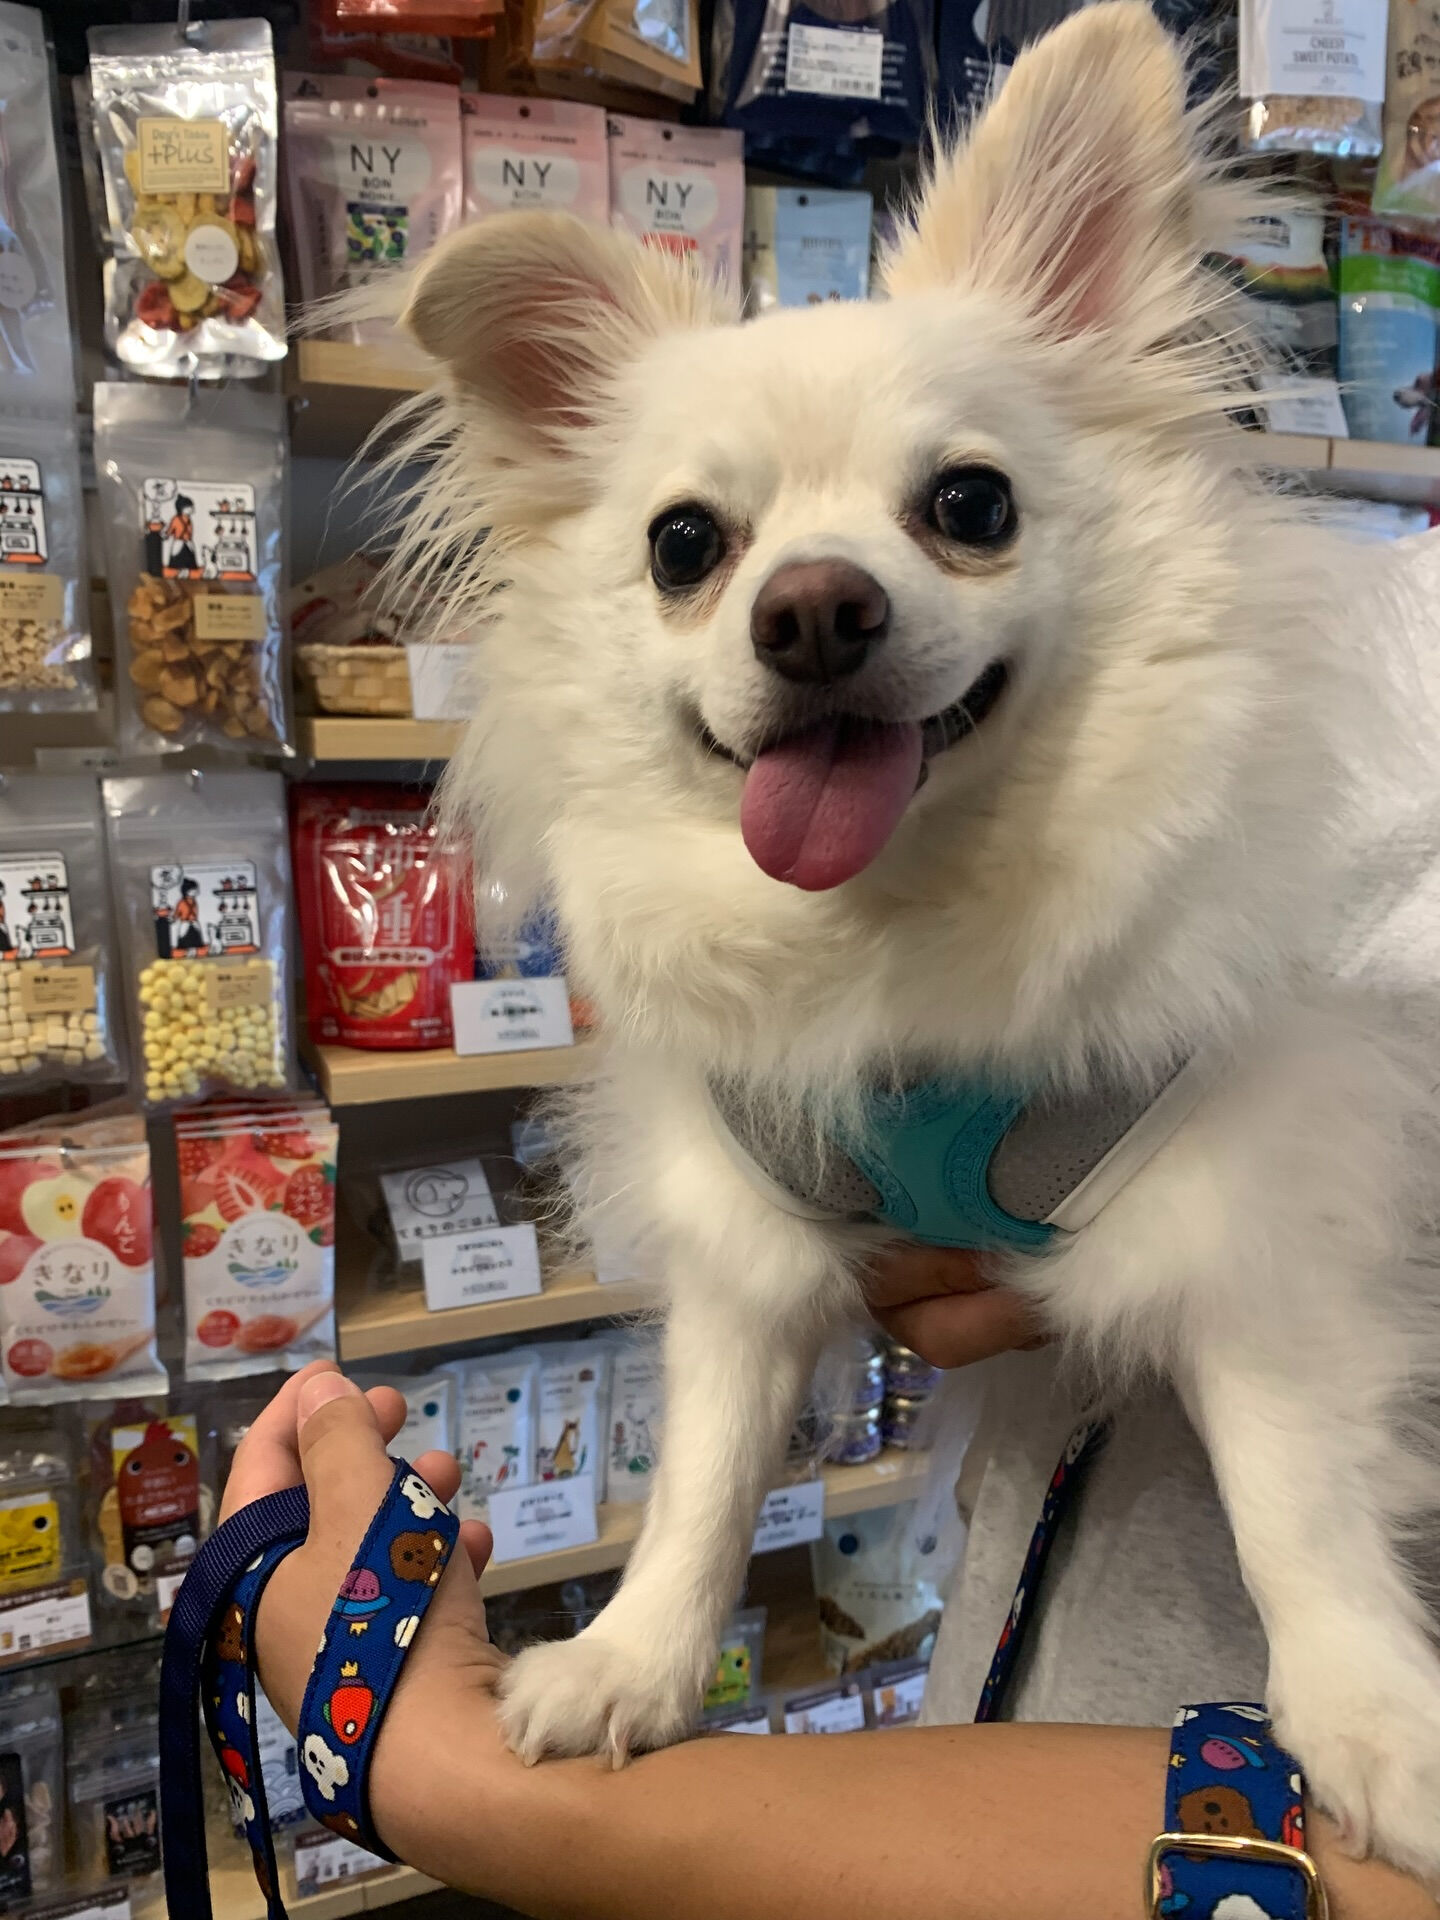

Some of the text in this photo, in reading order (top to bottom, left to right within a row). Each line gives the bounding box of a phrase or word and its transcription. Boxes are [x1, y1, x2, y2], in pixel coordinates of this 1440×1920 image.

[350, 144, 401, 174] NY
[502, 158, 552, 188] NY
[362, 177, 392, 189] BON
[646, 177, 693, 209] NY
[228, 1233, 299, 1260] きなり
[33, 1261, 110, 1288] きなり
